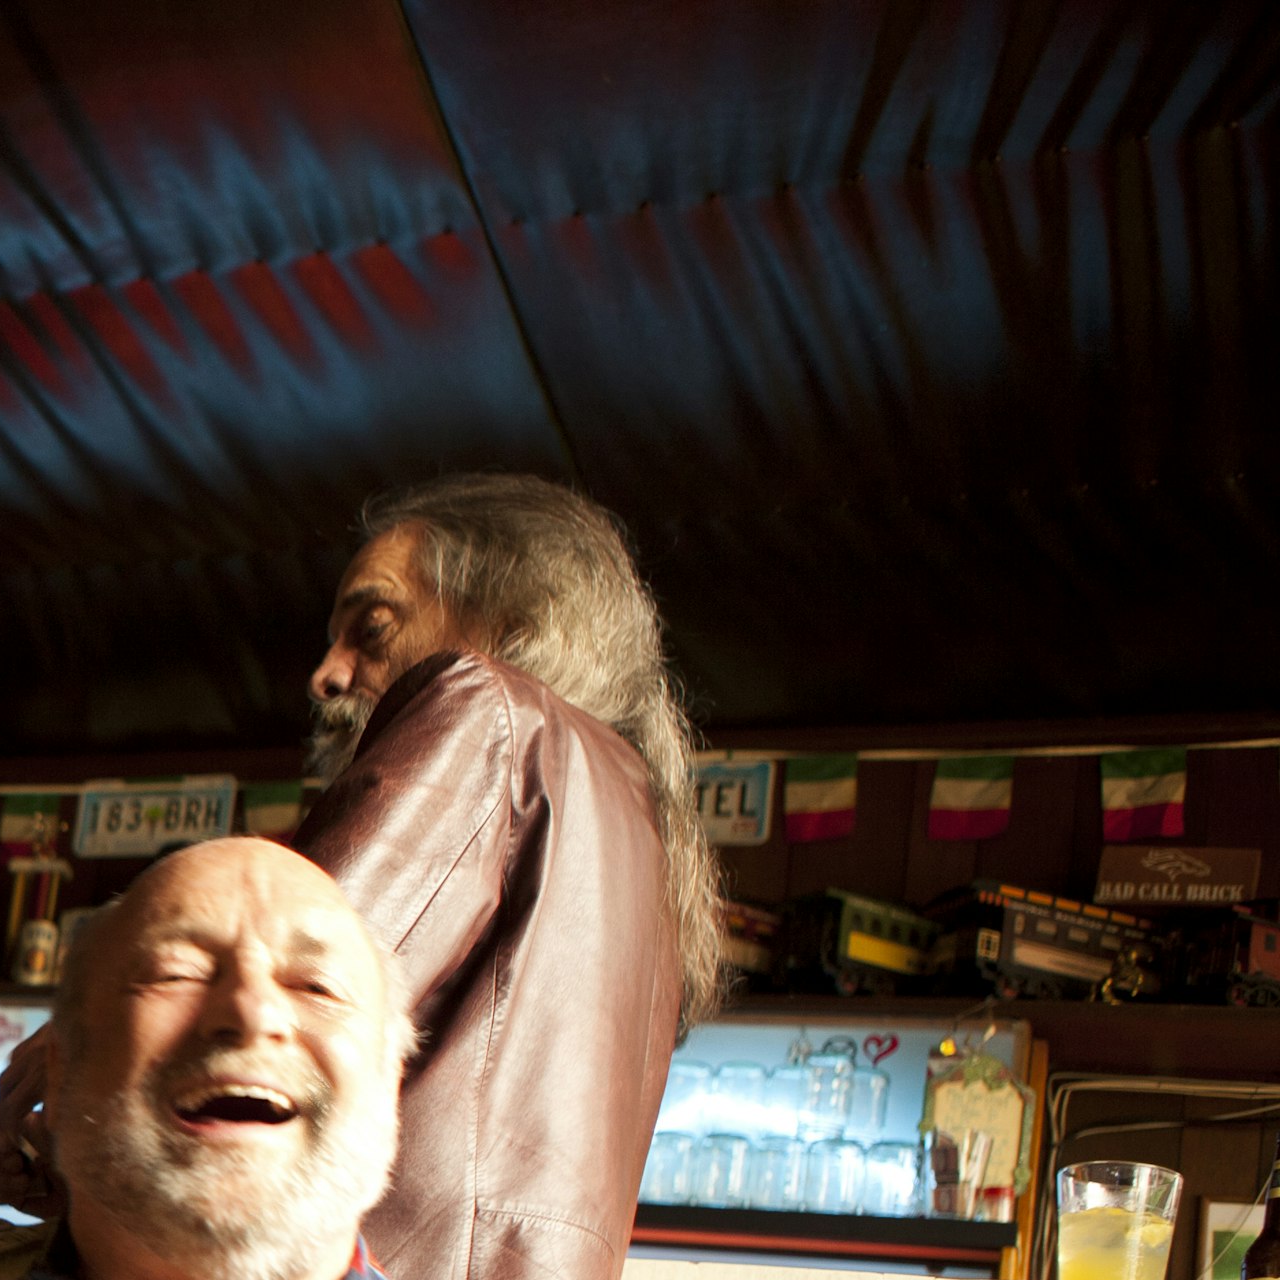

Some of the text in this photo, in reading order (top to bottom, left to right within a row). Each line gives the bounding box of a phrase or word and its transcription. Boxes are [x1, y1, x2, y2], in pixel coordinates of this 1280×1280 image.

[1098, 882, 1244, 902] BAD CALL BRICK
